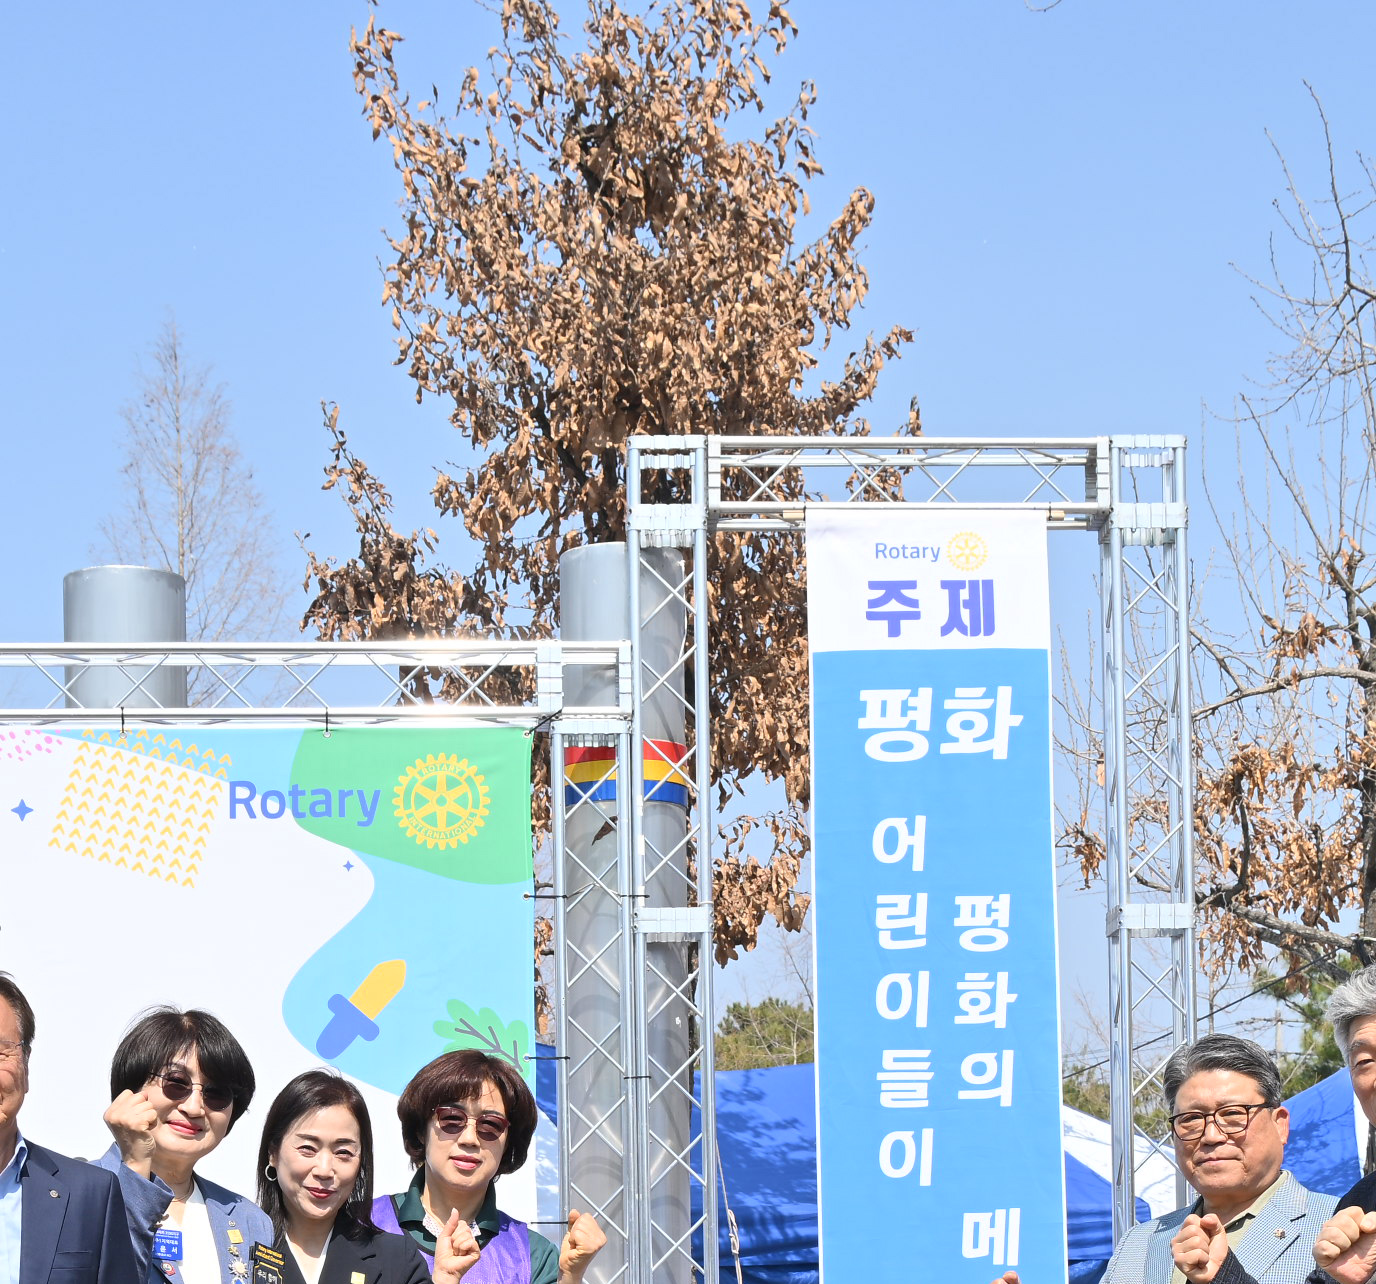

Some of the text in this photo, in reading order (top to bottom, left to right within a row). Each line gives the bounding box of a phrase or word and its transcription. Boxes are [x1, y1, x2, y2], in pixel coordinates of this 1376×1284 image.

[875, 542, 941, 563] Rotary
[857, 685, 1024, 763] 평화
[421, 762, 462, 776] ROTARY
[229, 780, 381, 828] Rotary
[408, 812, 479, 840] INTERNATIONAL
[953, 892, 1017, 1107] 평화의
